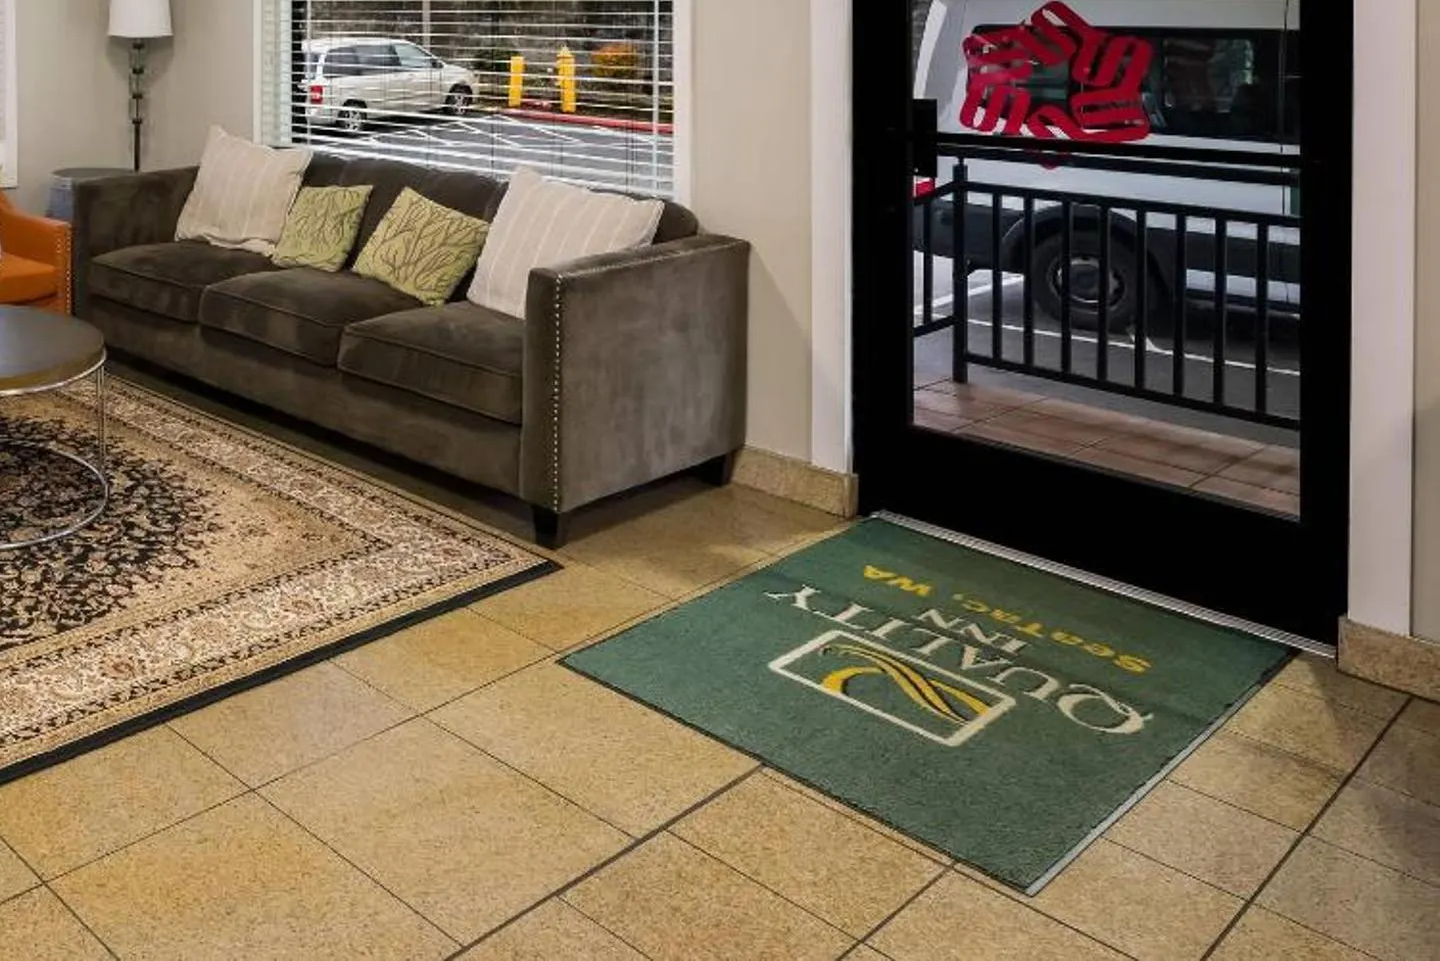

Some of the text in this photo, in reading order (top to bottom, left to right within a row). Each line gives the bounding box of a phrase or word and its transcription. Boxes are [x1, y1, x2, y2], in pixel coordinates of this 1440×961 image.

[862, 564, 933, 597] WA
[910, 609, 1030, 656] INN
[762, 583, 1155, 734] QUALITY
